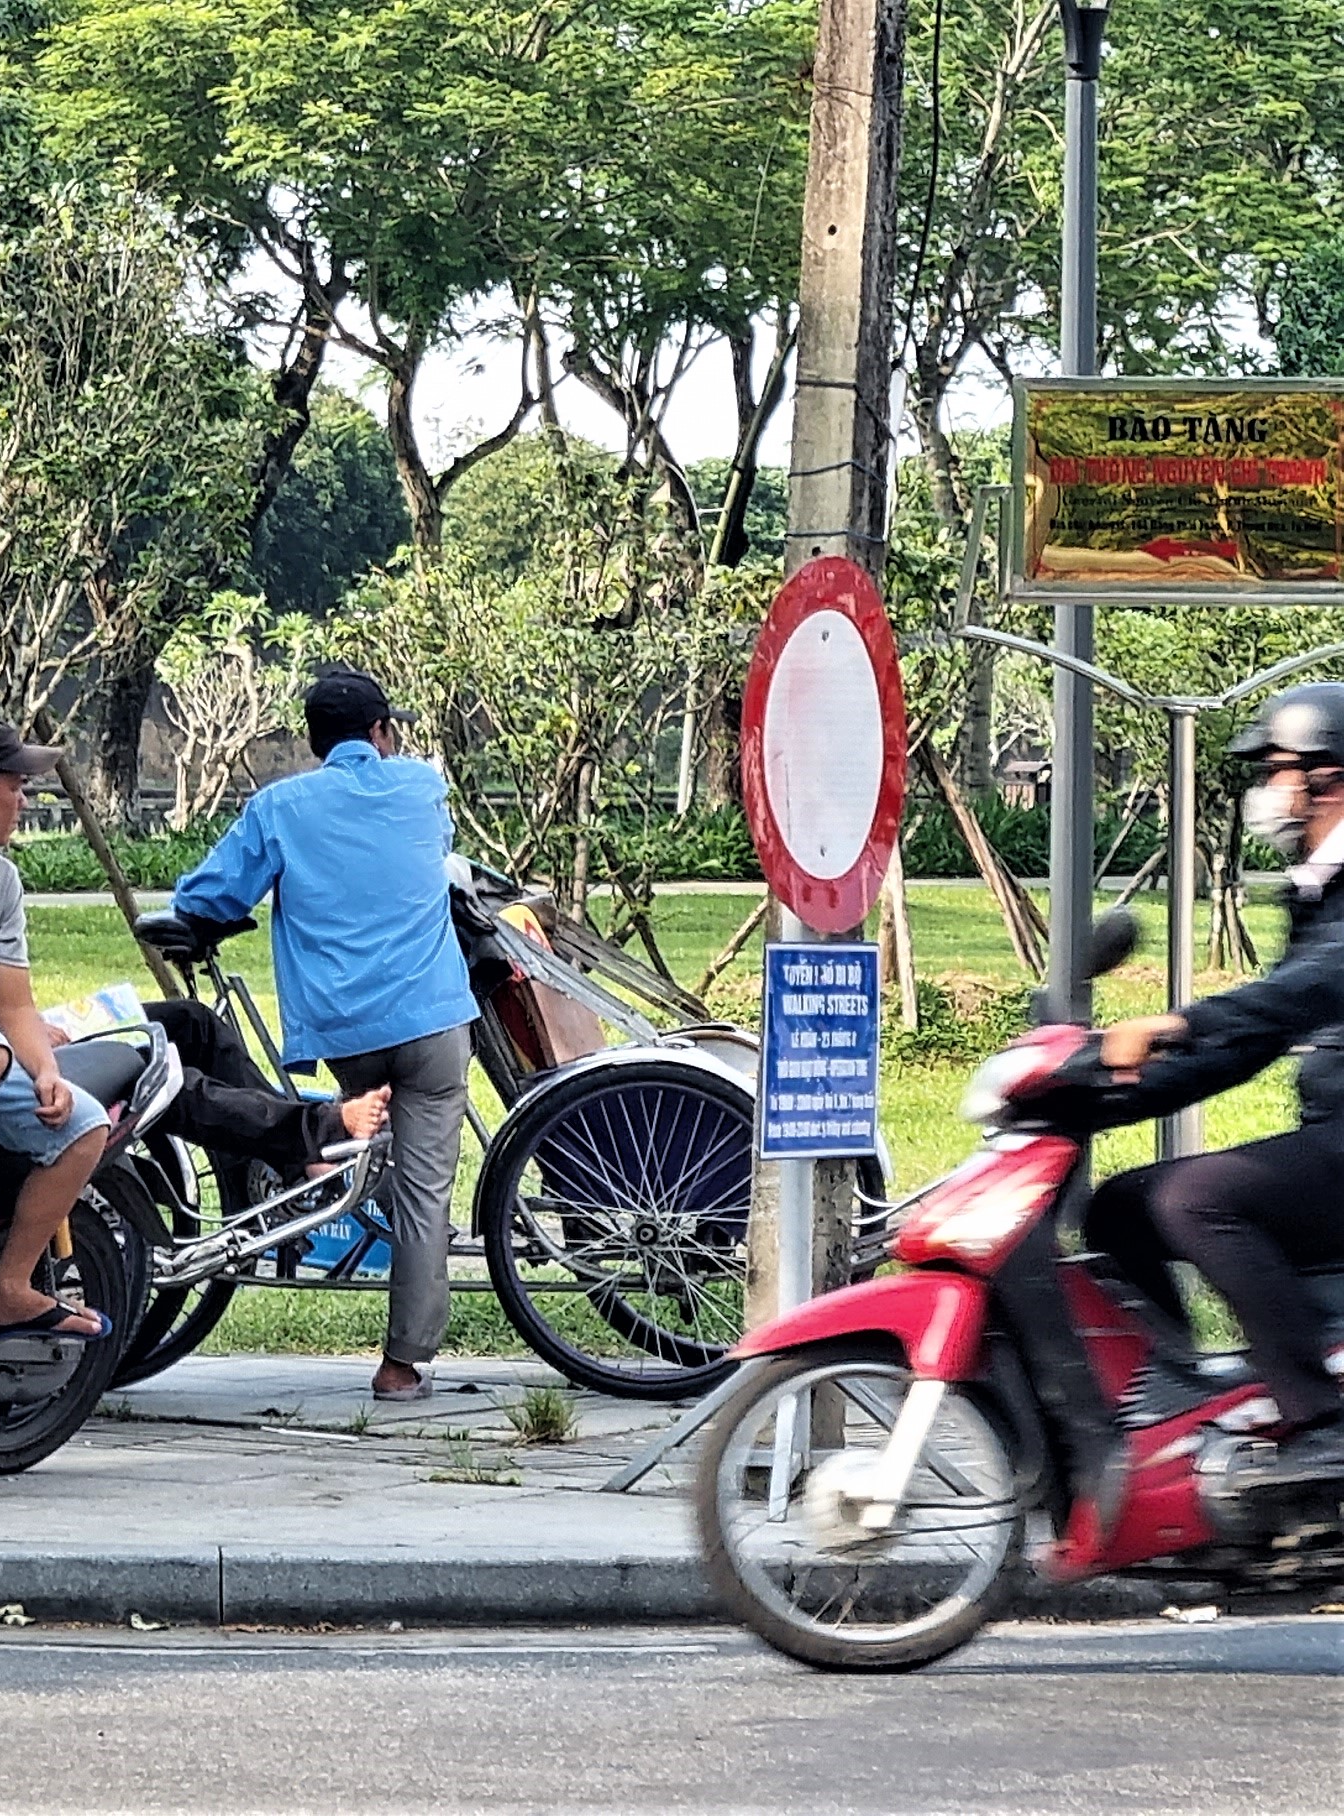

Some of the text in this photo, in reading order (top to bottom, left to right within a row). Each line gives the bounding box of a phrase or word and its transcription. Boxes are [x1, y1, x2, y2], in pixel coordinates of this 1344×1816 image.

[1183, 411, 1269, 444] TÀNG
[782, 994, 869, 1017] WALKING STREETS
